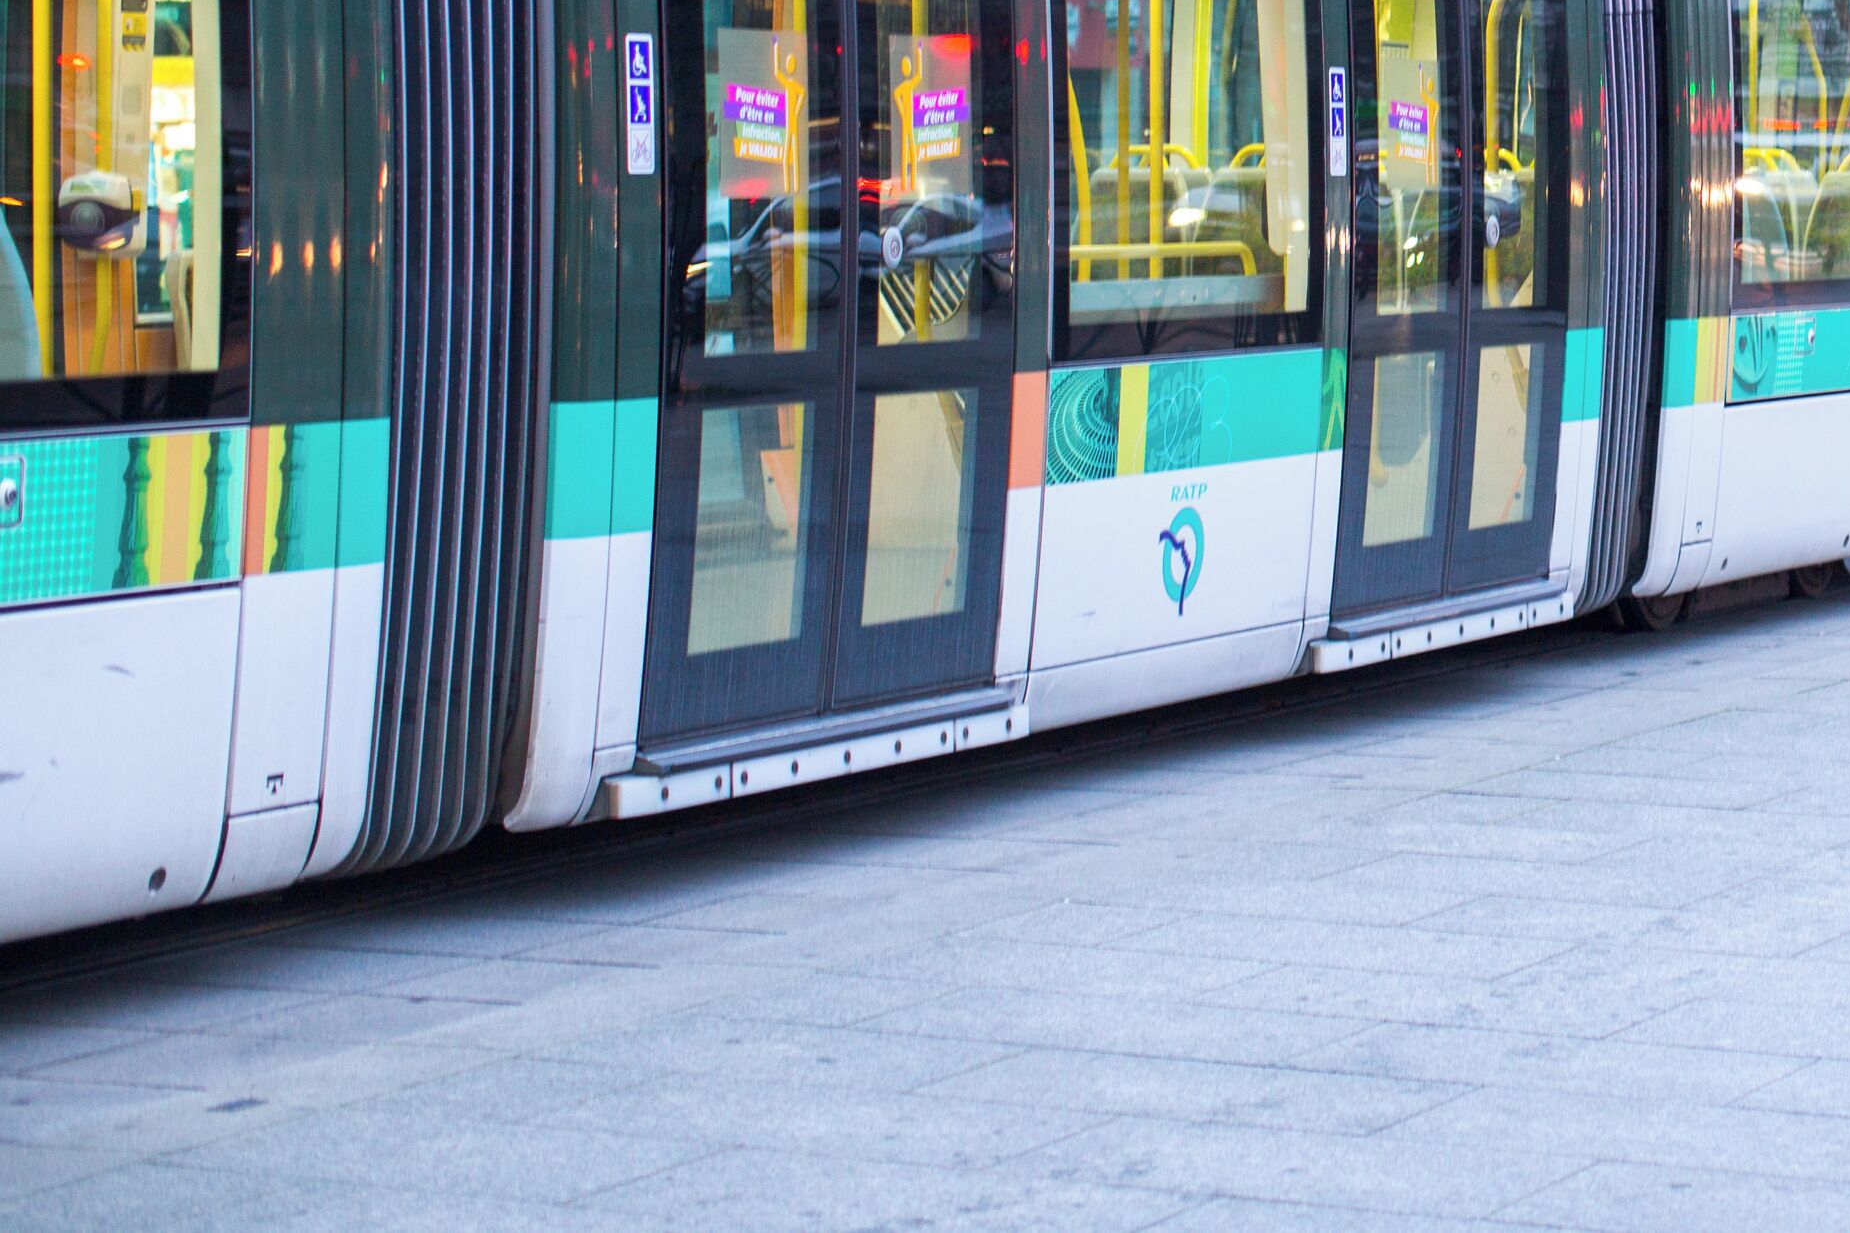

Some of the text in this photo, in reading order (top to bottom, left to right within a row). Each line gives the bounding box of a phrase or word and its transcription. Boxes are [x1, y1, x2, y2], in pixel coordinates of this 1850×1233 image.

[735, 86, 779, 108] Pour éviter
[919, 89, 958, 109] Pour éviter
[740, 104, 775, 124] d'être en
[924, 109, 955, 126] d'être en
[1170, 482, 1208, 502] RATP
